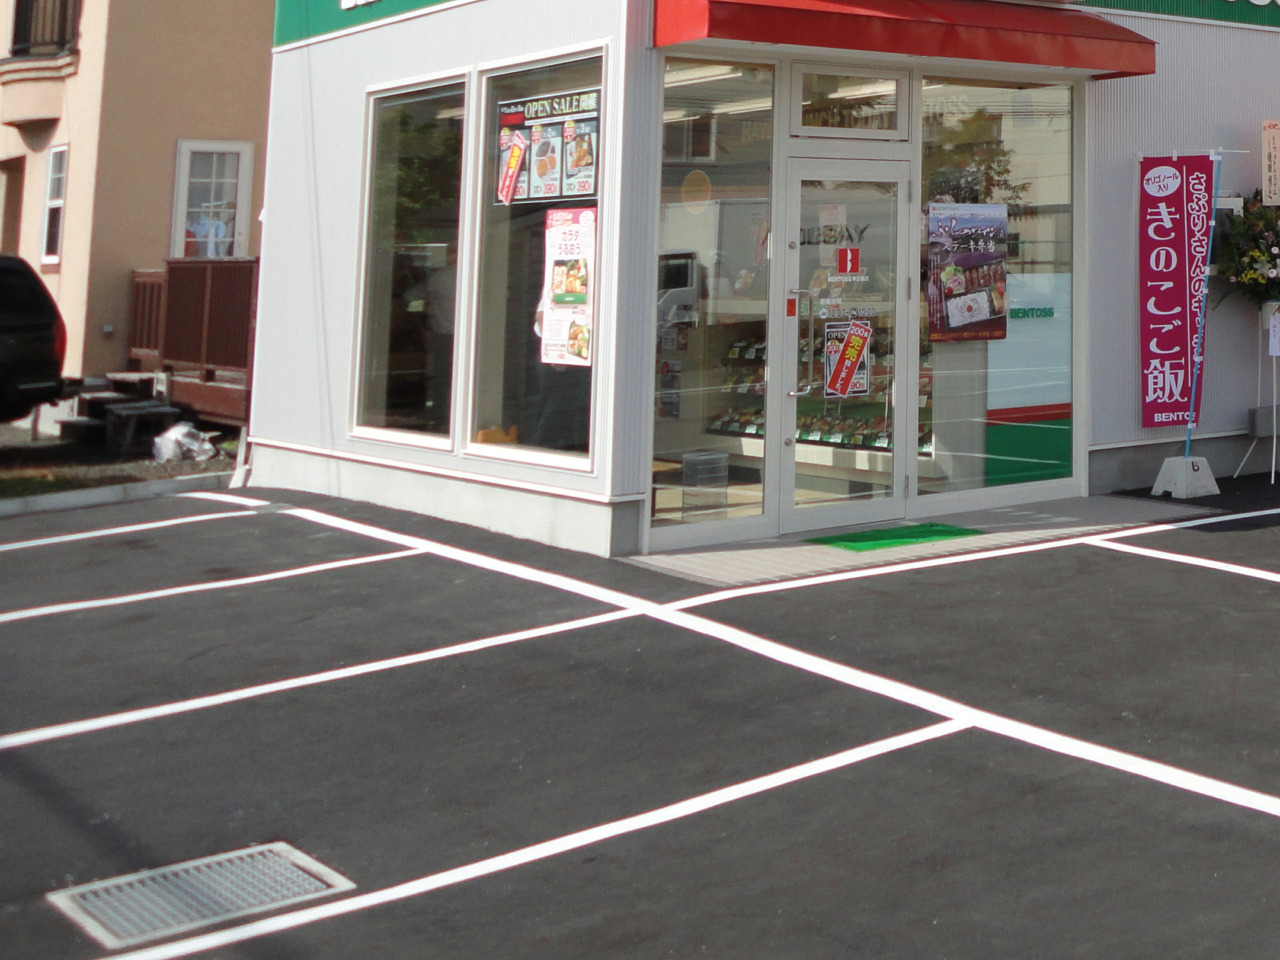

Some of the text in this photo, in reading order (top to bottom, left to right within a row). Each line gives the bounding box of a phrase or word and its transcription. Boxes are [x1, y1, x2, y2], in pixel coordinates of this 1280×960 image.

[524, 100, 551, 119] OPEN
[1144, 173, 1180, 186] オリゴノール
[1157, 184, 1169, 193] 入り
[942, 239, 996, 253] ステーキ弁当
[1144, 201, 1188, 403] きのこご飯
[1010, 307, 1055, 319] BENTOSS
[1154, 411, 1196, 422] BENTO
